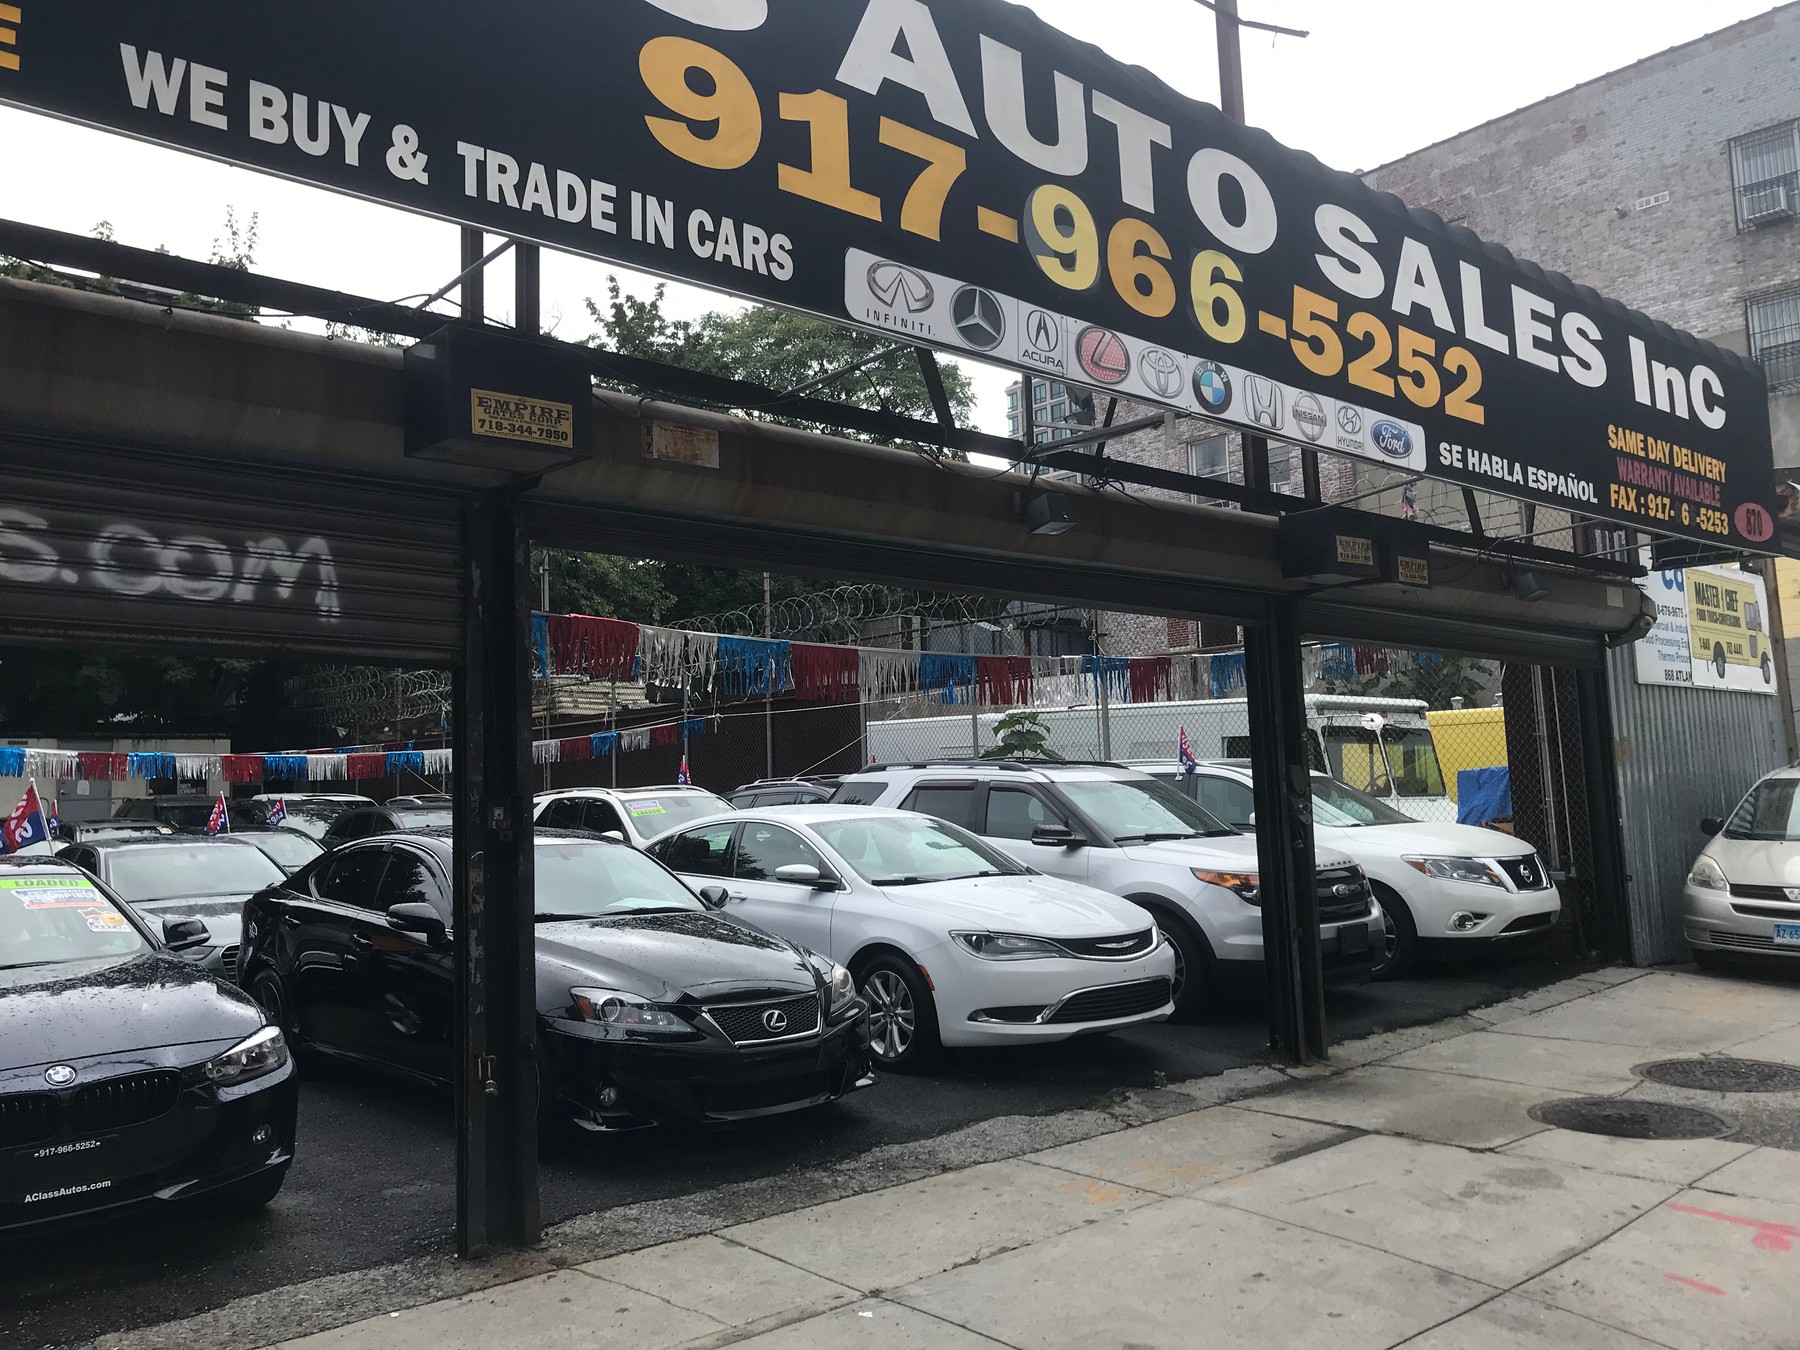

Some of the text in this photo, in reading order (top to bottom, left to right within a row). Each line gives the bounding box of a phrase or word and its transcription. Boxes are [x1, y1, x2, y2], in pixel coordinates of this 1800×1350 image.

[120, 43, 794, 281] WE BUY & TRADE IN CARS
[1315, 203, 1607, 388] SALES
[866, 308, 932, 335] INFINITI
[1022, 349, 1064, 370] ACURA
[476, 396, 570, 421] EMPIRE
[484, 407, 562, 427] GATES CORP.
[1295, 409, 1324, 424] NISSAN
[479, 419, 568, 441] 718-344-7950
[1379, 426, 1406, 452] Ford
[1608, 424, 1727, 483] SAME DAY DELIVERY
[1439, 442, 1599, 504] SE HABLA ESPAÑOL
[1616, 456, 1721, 507] WARRANTY AVAILABLE
[1610, 483, 1638, 514] FAX
[1339, 540, 1371, 551] EMPIRE
[1694, 581, 1720, 609] MASTER
[1655, 635, 1681, 650] Processing
[1664, 669, 1675, 681] 868
[14, 879, 80, 888] LOADED
[39, 1140, 96, 1157] 917-966-5252
[24, 1179, 111, 1203] AClassAutos.com
